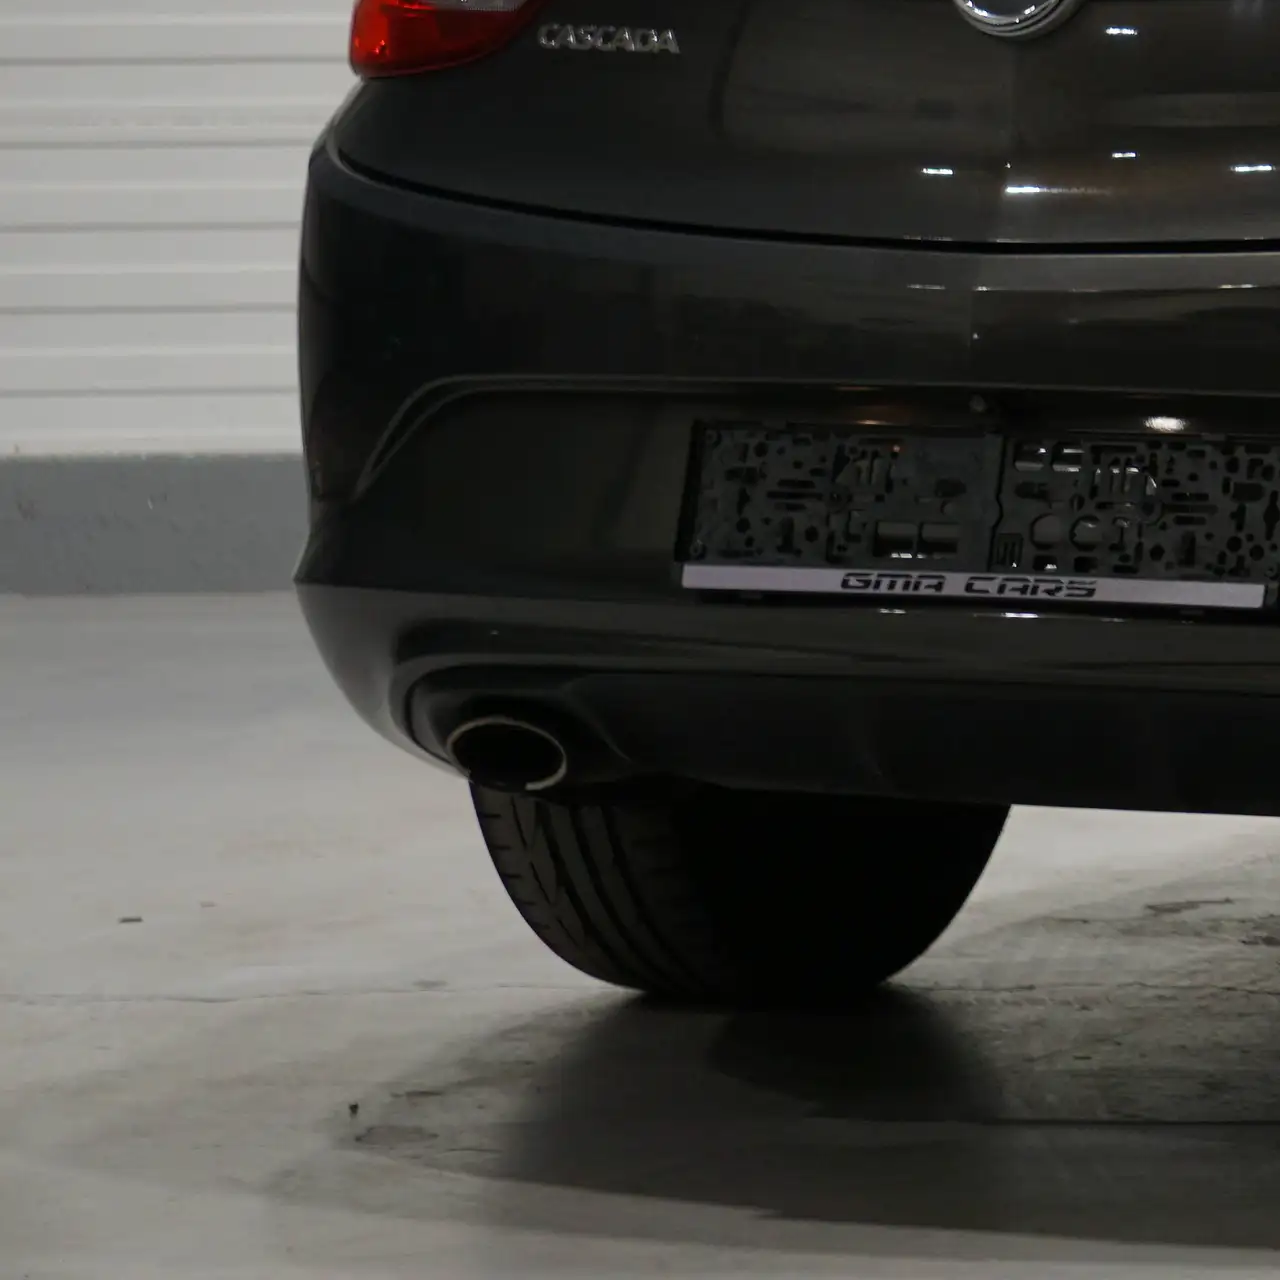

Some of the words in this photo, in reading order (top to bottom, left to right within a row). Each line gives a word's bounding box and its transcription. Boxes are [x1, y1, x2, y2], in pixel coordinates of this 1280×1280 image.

[537, 23, 681, 54] CASCADA
[840, 572, 946, 593] GMA
[964, 576, 1097, 598] CARS
